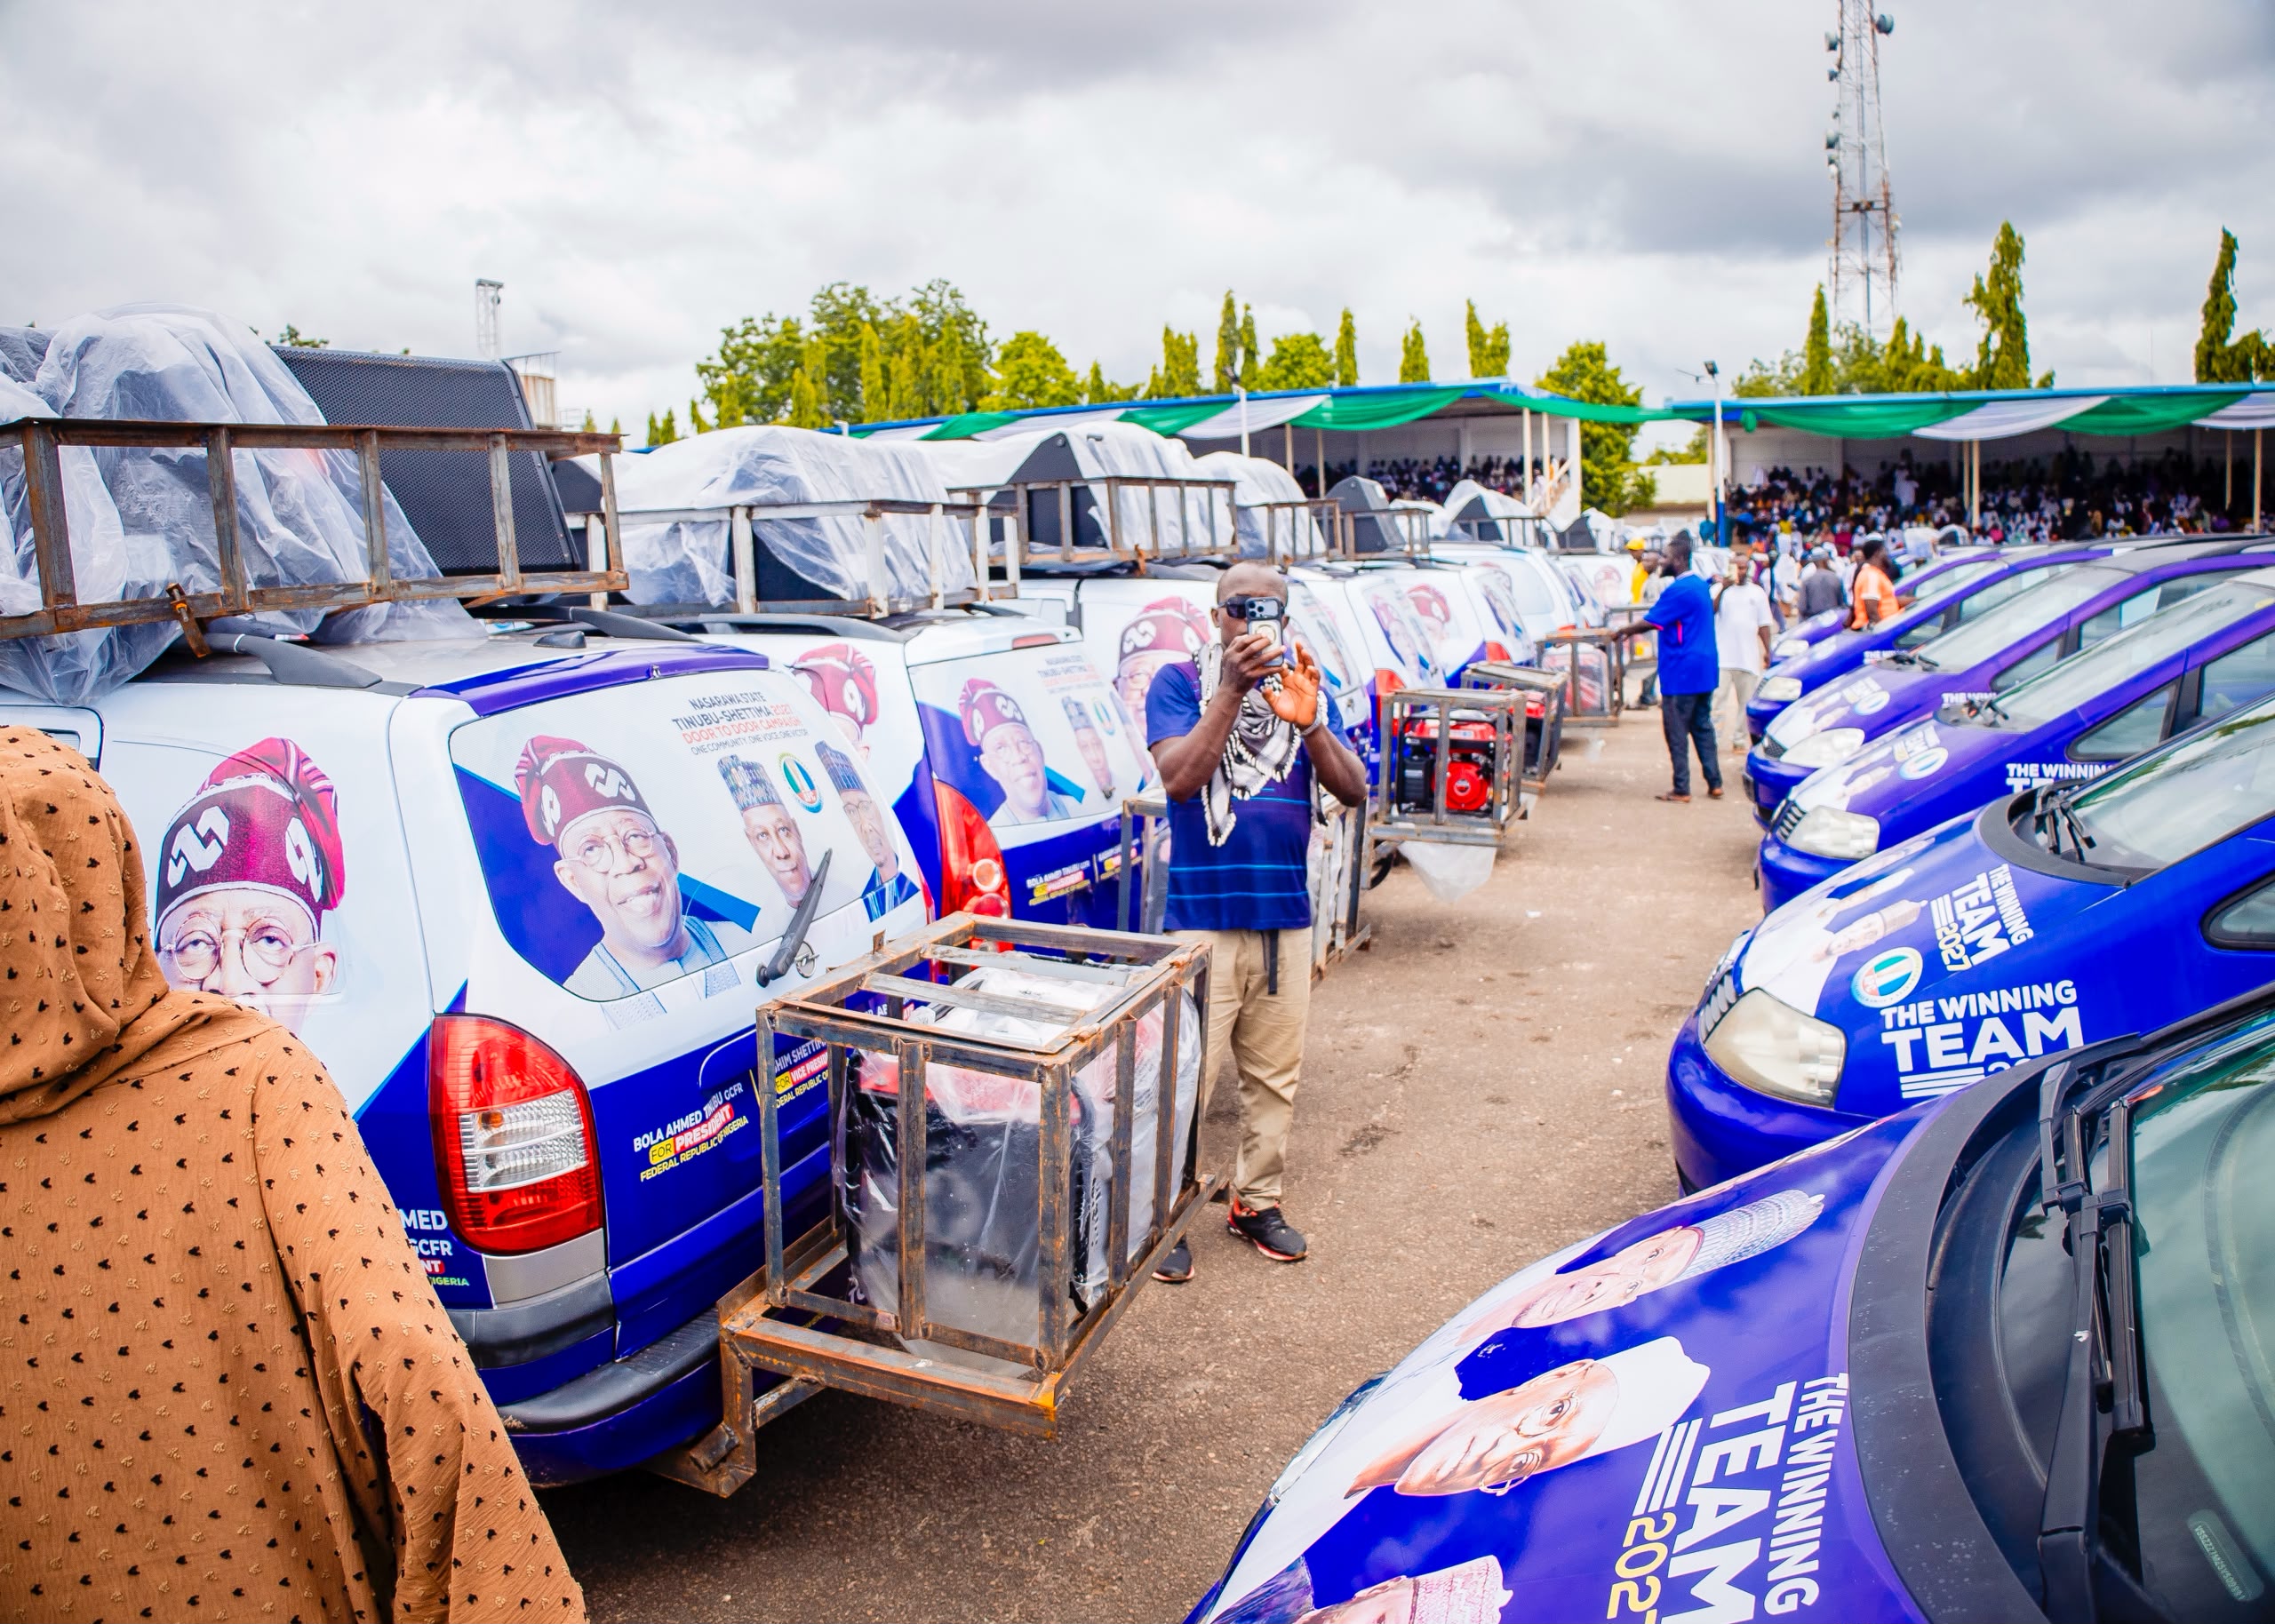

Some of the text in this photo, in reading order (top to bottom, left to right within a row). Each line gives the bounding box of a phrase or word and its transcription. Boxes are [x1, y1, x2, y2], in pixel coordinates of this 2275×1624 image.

[672, 704, 794, 730] TINUBU-SHETTIMA 2027
[689, 691, 767, 710] NASARAWA STATE
[682, 728, 717, 744] DOOR
[715, 725, 731, 737] TO
[731, 721, 760, 735] DOOR
[690, 744, 708, 755] ONE
[748, 734, 763, 744] ONE
[2006, 763, 2110, 778] THE WINNIN
[1952, 872, 2011, 967] TEAM
[1989, 863, 2034, 946] THE WINNING
[1936, 921, 1973, 972] 2027
[1880, 980, 2078, 1031] THE WINNING
[1881, 1007, 2085, 1073] TEAM
[776, 1091, 796, 1109] DERAL
[794, 1074, 823, 1096] REPUBLIC
[790, 1065, 807, 1082] VICE
[633, 1127, 665, 1152] BOLA
[666, 1110, 703, 1138] AHMED
[723, 1082, 744, 1101] GCFR
[651, 1103, 731, 1161] FOR PRESIDENT
[640, 1158, 680, 1182] FEDERAL
[680, 1136, 718, 1163] REPUBLIC
[723, 1115, 749, 1138] NIGERIA
[398, 1208, 448, 1230] MED
[1658, 1381, 1797, 1624] TEAM
[1763, 1372, 1849, 1616] THE WINNING
[1606, 1511, 1678, 1624] 202
